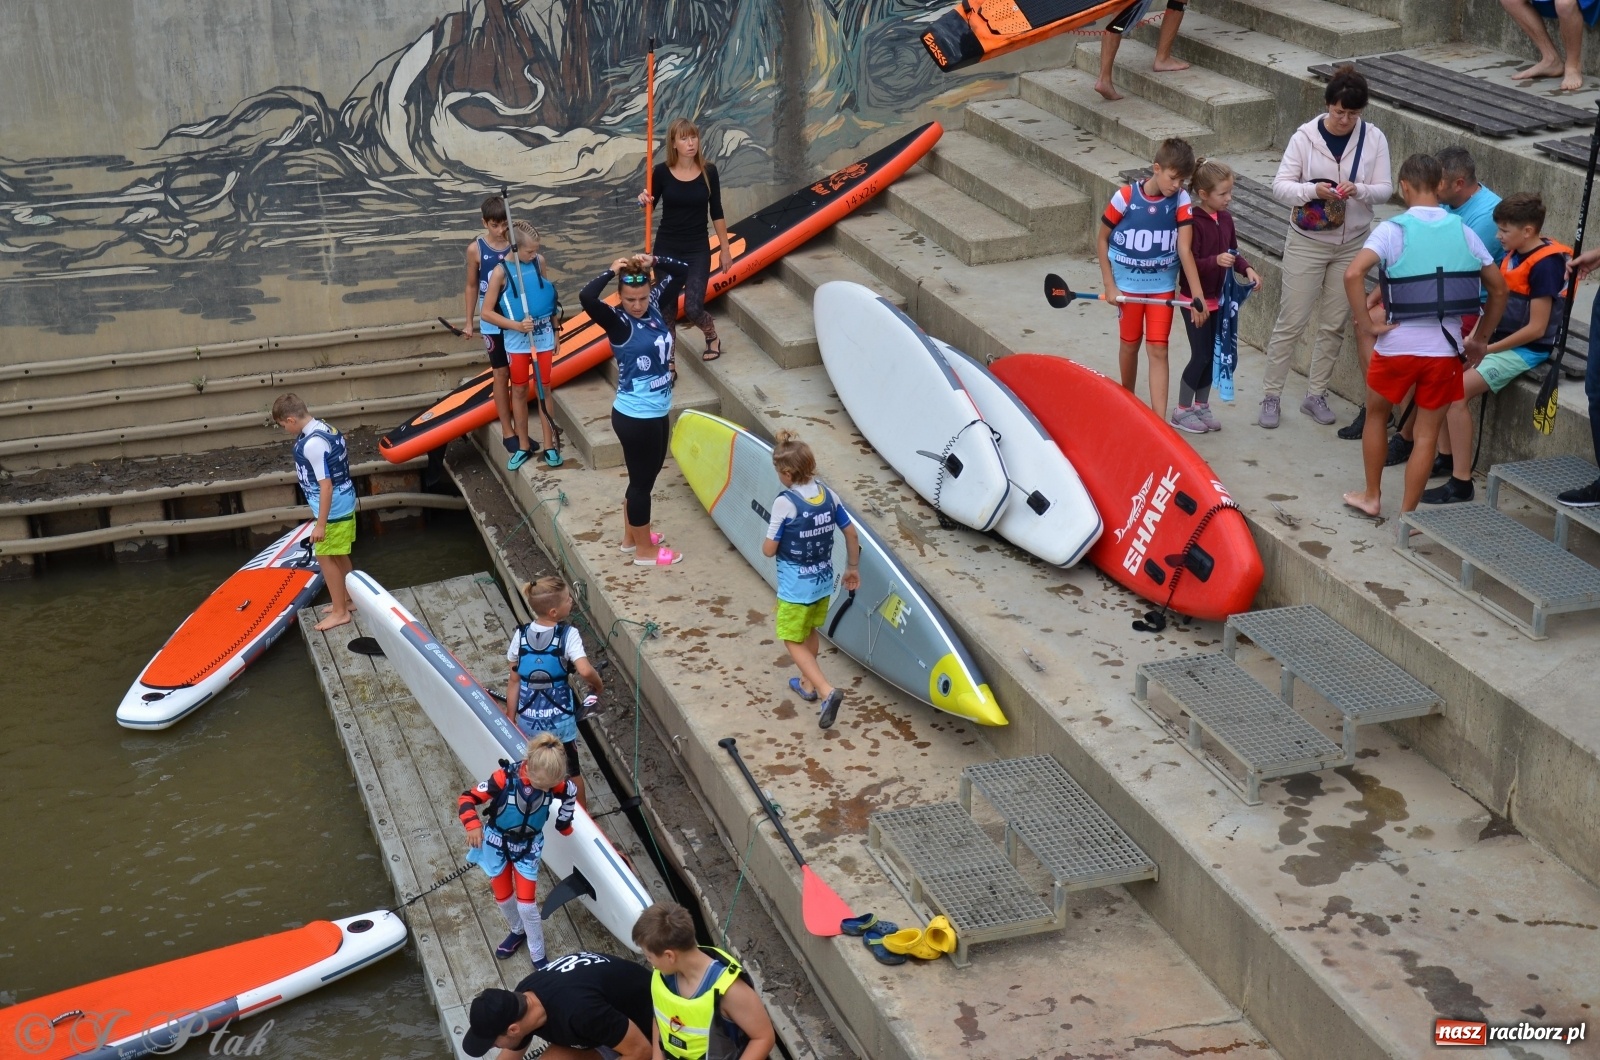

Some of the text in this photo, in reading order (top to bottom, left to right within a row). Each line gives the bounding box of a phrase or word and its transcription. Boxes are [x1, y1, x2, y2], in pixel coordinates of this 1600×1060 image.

[1124, 228, 1171, 252] 104
[812, 511, 832, 526] 105
[1123, 465, 1181, 577] SHARK
